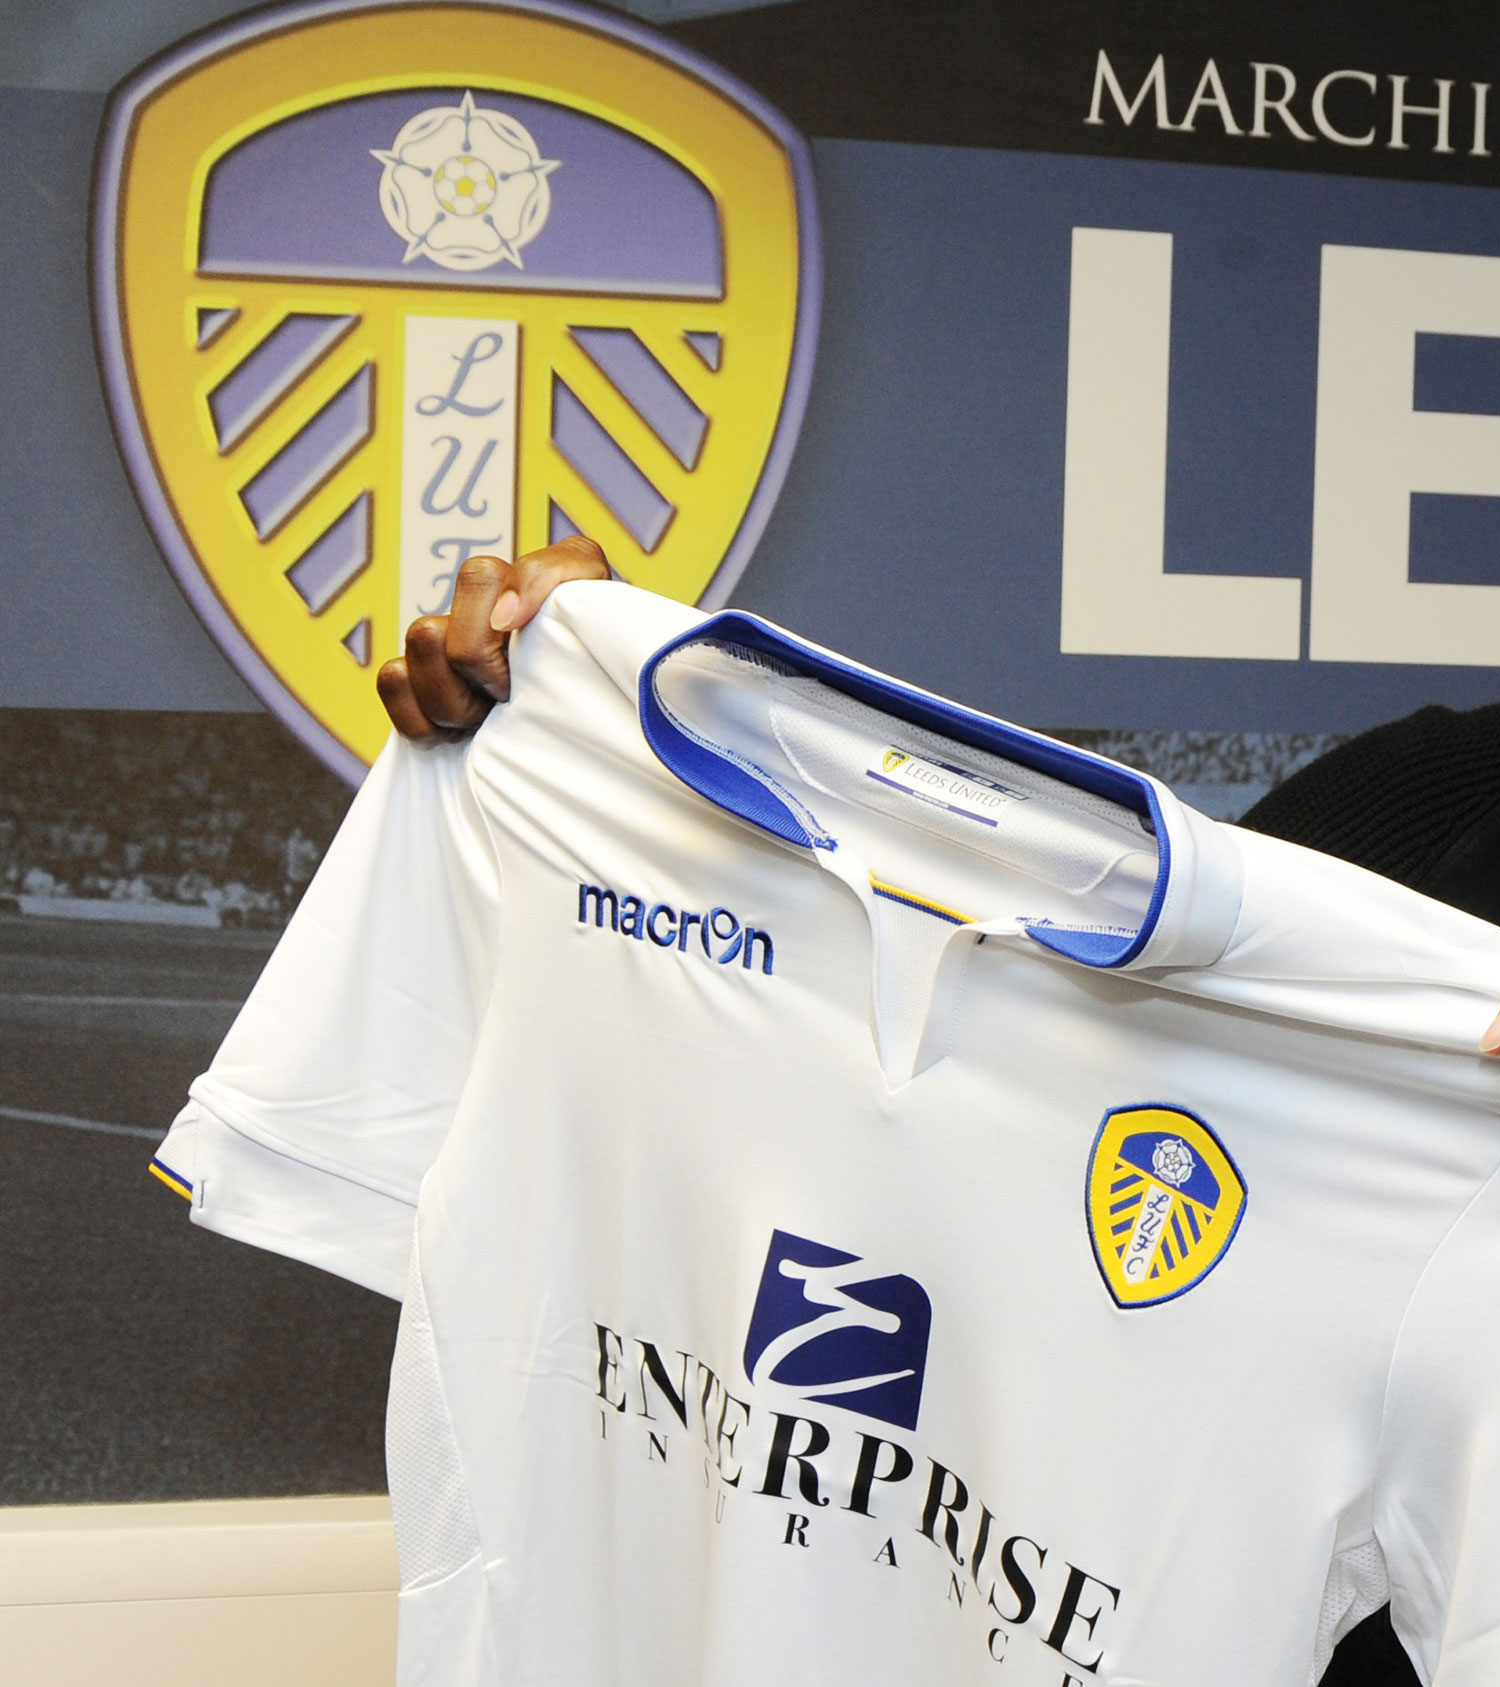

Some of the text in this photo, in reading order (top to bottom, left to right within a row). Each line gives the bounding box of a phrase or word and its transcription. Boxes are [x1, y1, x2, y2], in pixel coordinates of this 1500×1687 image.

[905, 763, 949, 789] LEEDS
[948, 780, 1002, 808] UNITED
[578, 883, 774, 975] macron
[593, 1322, 1121, 1675] ENTERPRISE
